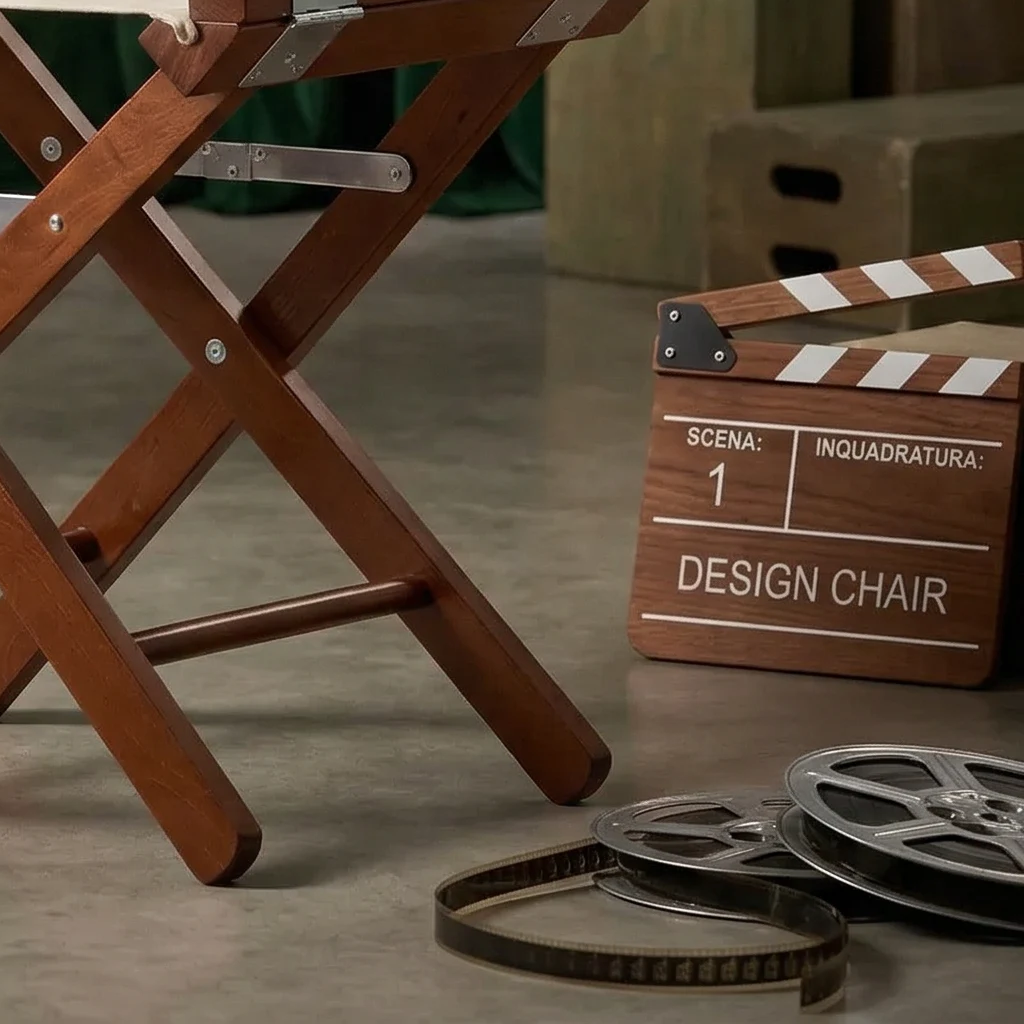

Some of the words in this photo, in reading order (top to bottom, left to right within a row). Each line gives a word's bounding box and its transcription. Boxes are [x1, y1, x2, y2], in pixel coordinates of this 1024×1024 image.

[686, 426, 762, 452] SCENA:
[815, 437, 984, 470] INQUADRATURA:
[708, 462, 725, 507] 1
[677, 554, 818, 602] DESIGN
[831, 568, 947, 614] CHAIR
